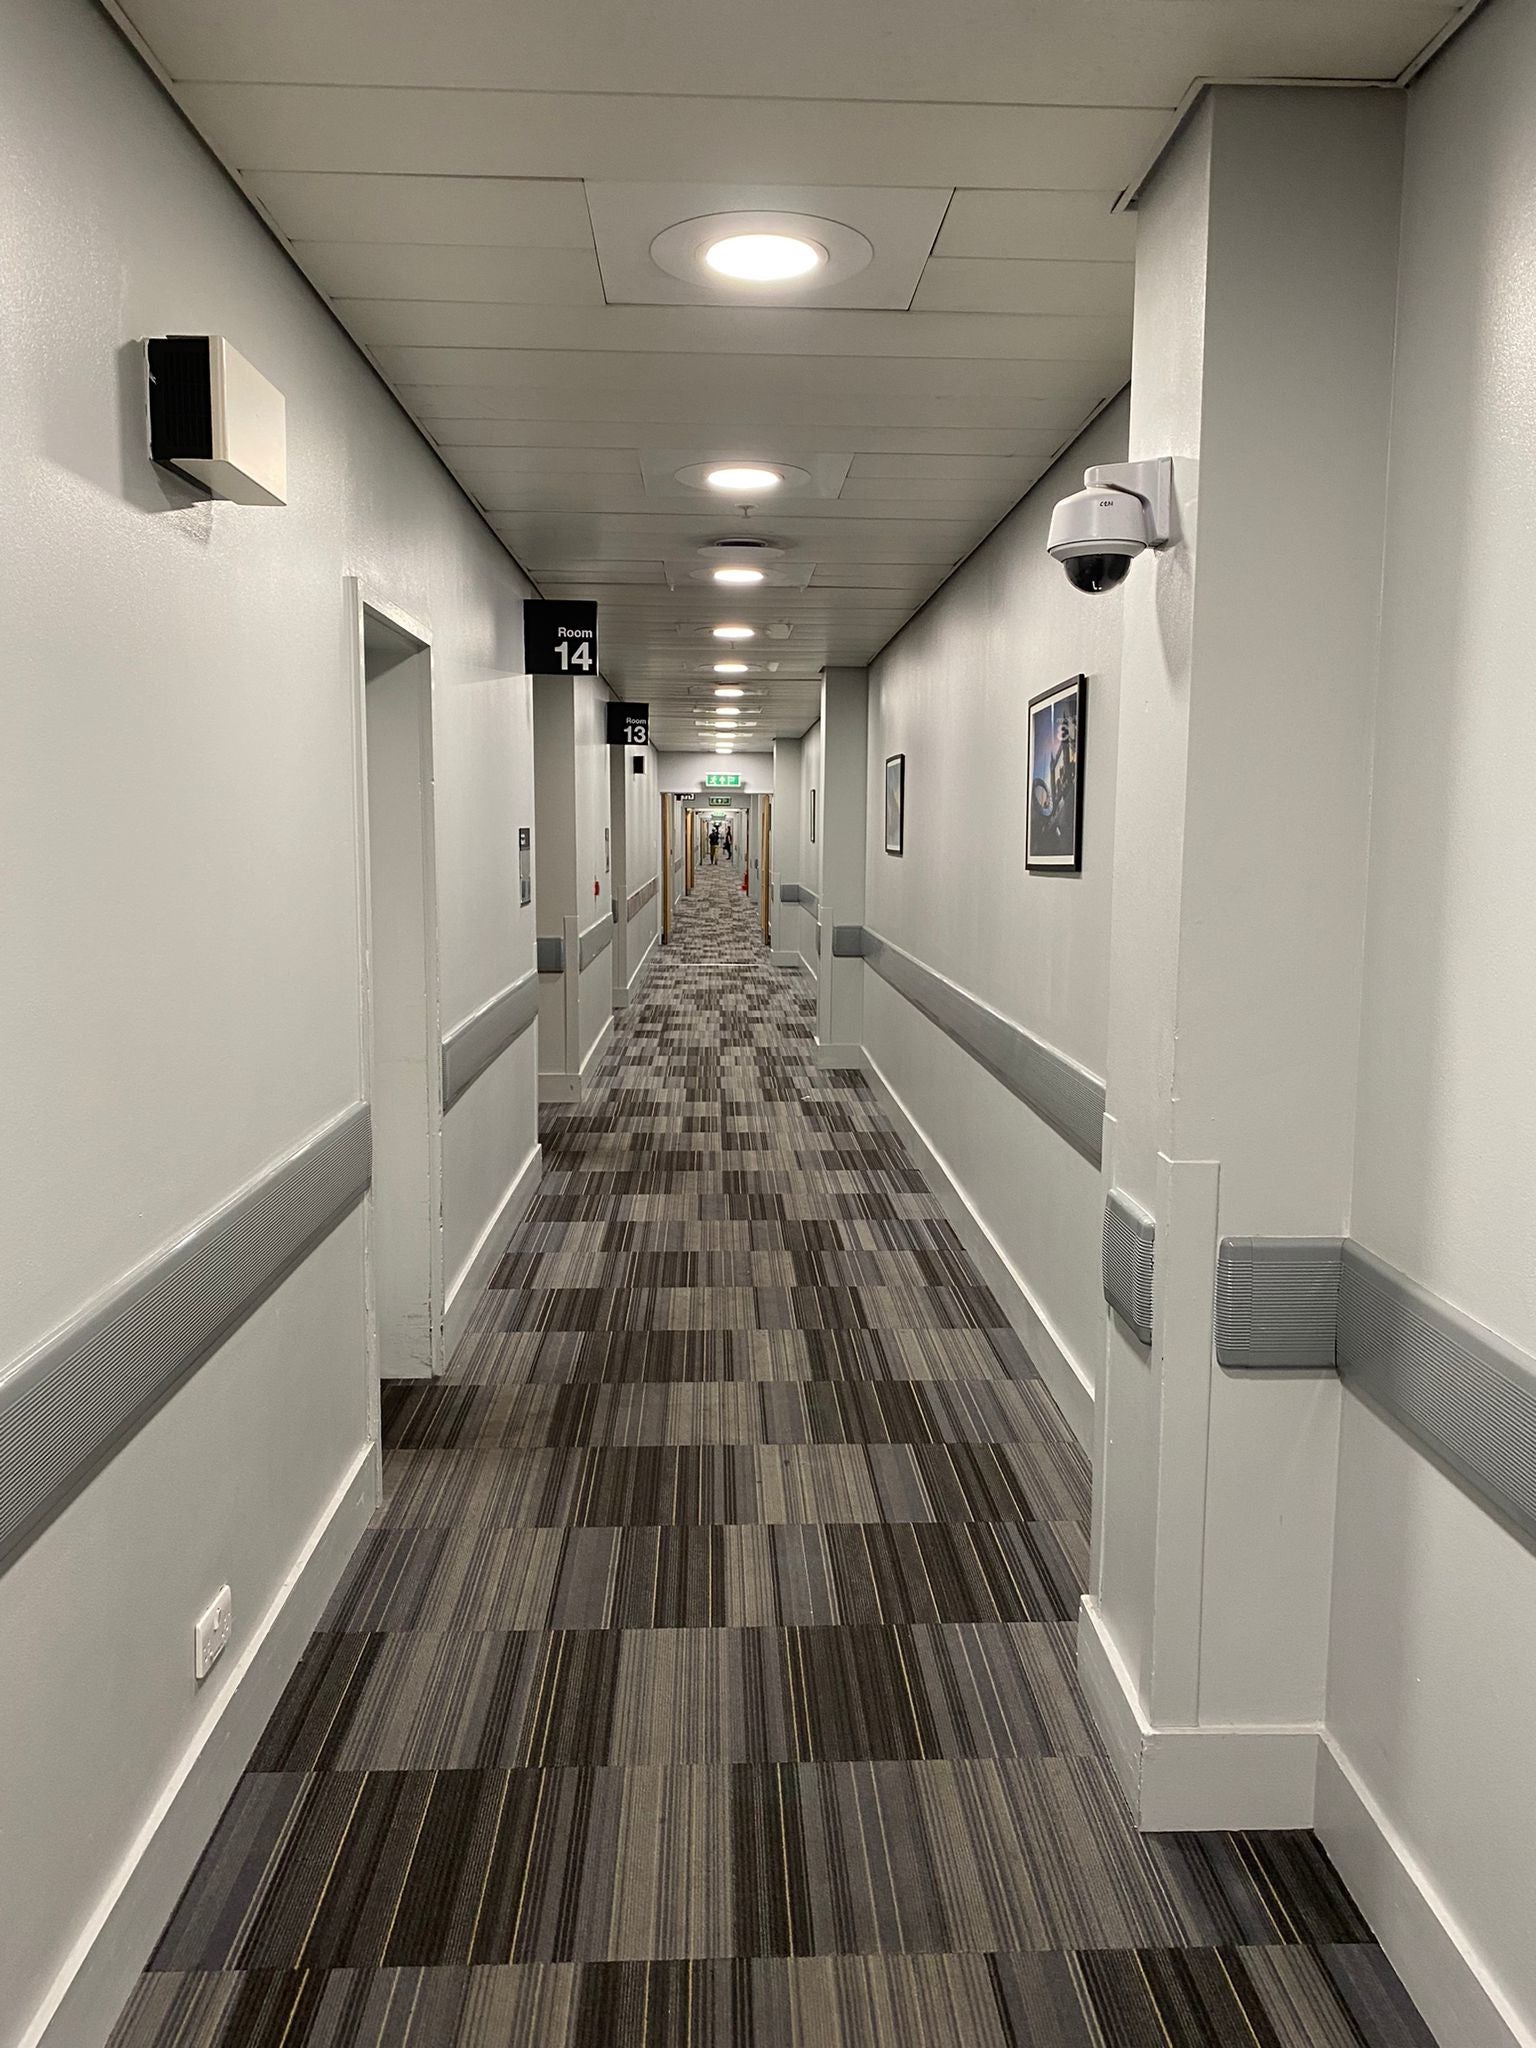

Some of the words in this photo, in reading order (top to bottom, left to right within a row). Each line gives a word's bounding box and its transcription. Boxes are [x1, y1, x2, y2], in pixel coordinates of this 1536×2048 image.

[558, 626, 593, 638] Room
[554, 641, 593, 671] 14
[626, 716, 647, 725] Room
[623, 725, 646, 743] 13
